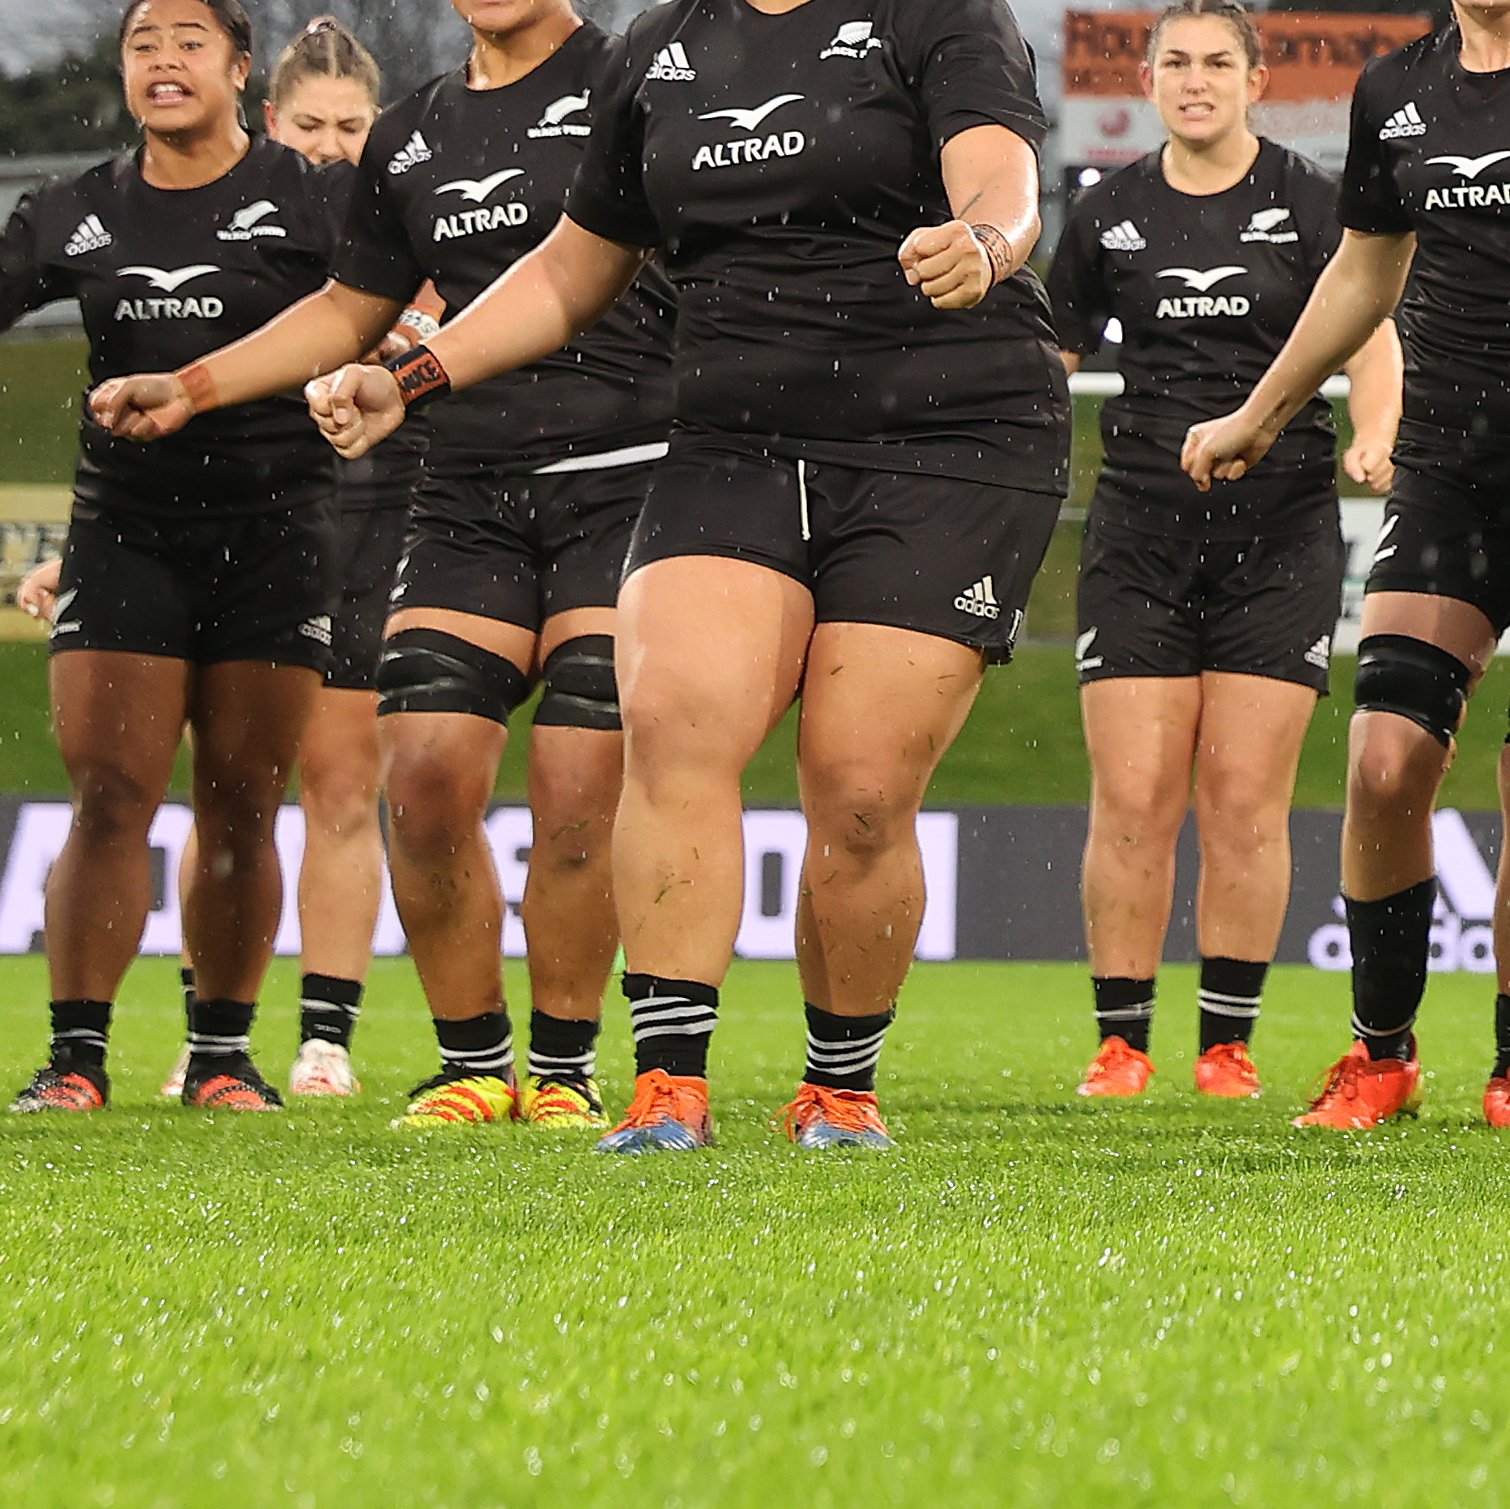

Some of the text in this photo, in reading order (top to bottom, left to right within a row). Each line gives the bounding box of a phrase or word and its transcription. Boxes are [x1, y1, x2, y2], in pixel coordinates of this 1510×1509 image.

[691, 130, 805, 170] ALTRAD
[432, 202, 529, 242] ALTRAD
[114, 297, 224, 321] ALTRAD
[1156, 295, 1250, 318] ALTRAD
[953, 594, 1001, 620] adidas
